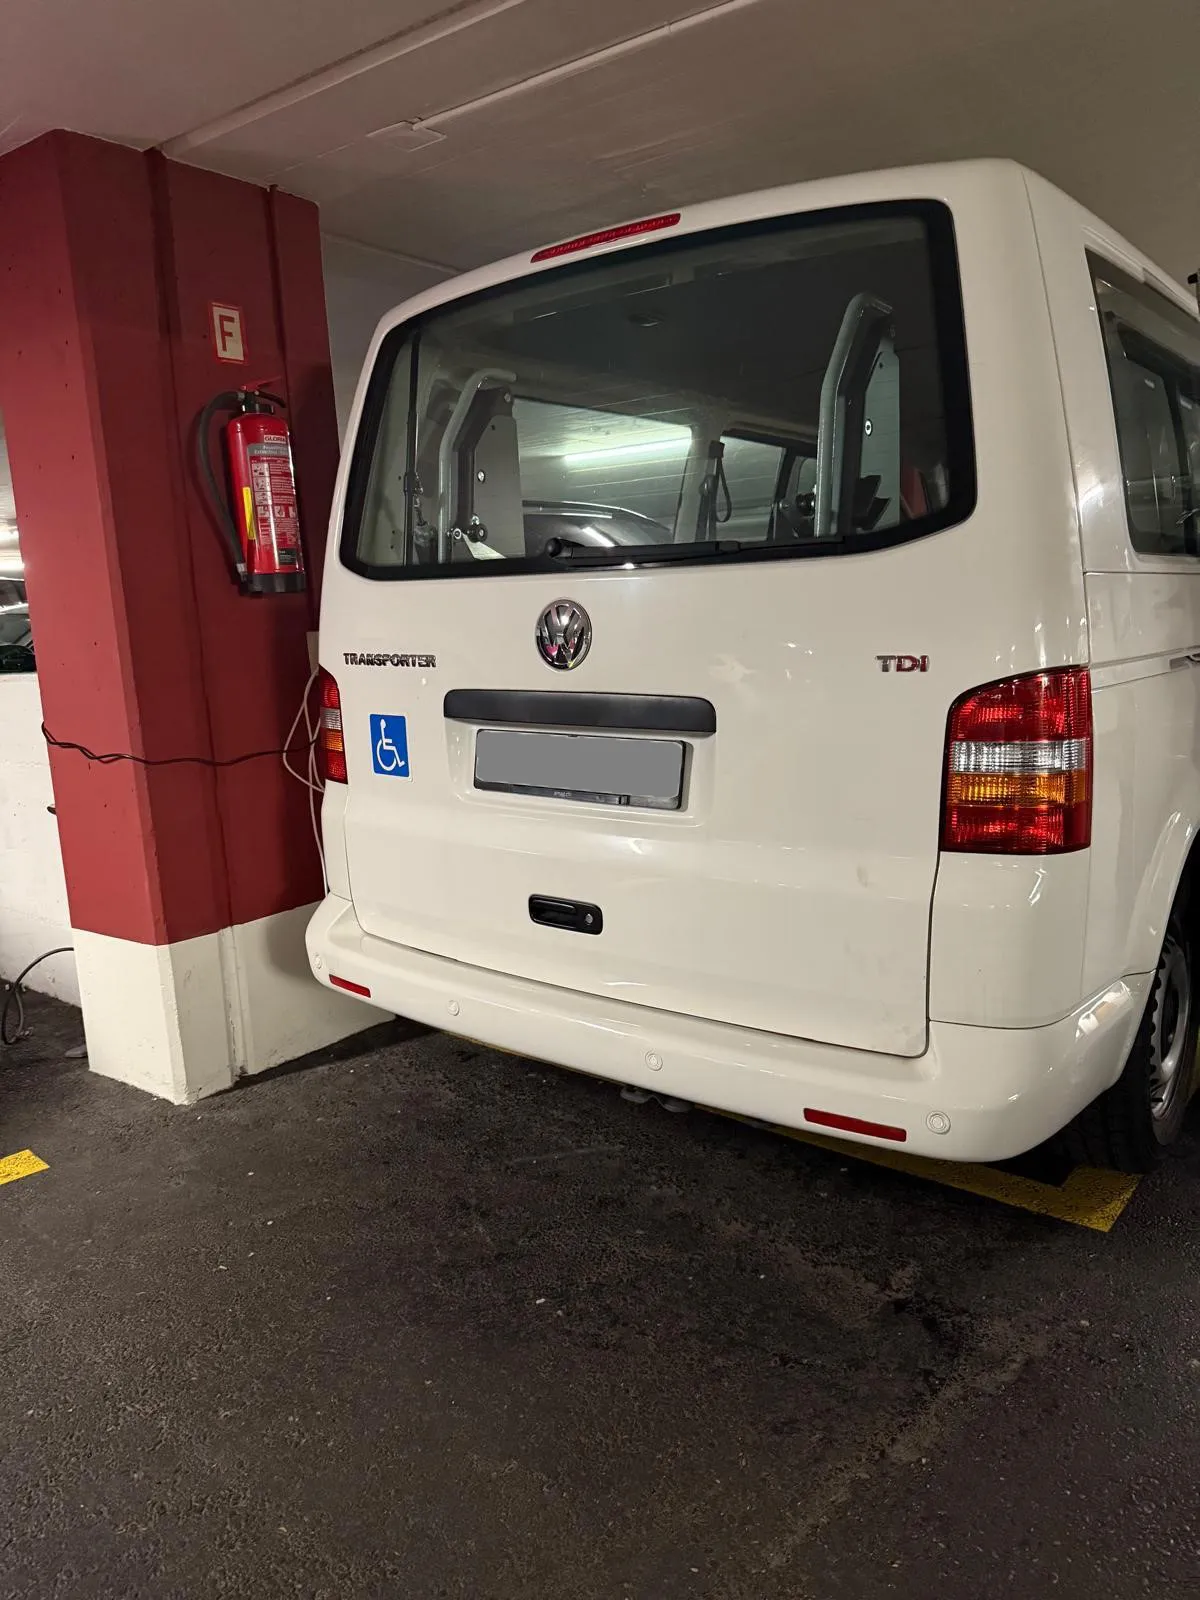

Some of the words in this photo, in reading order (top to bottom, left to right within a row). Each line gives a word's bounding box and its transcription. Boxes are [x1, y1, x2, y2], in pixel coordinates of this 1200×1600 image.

[219, 314, 235, 352] F
[343, 652, 436, 667] TRANSPORTER
[876, 655, 929, 672] TDI
